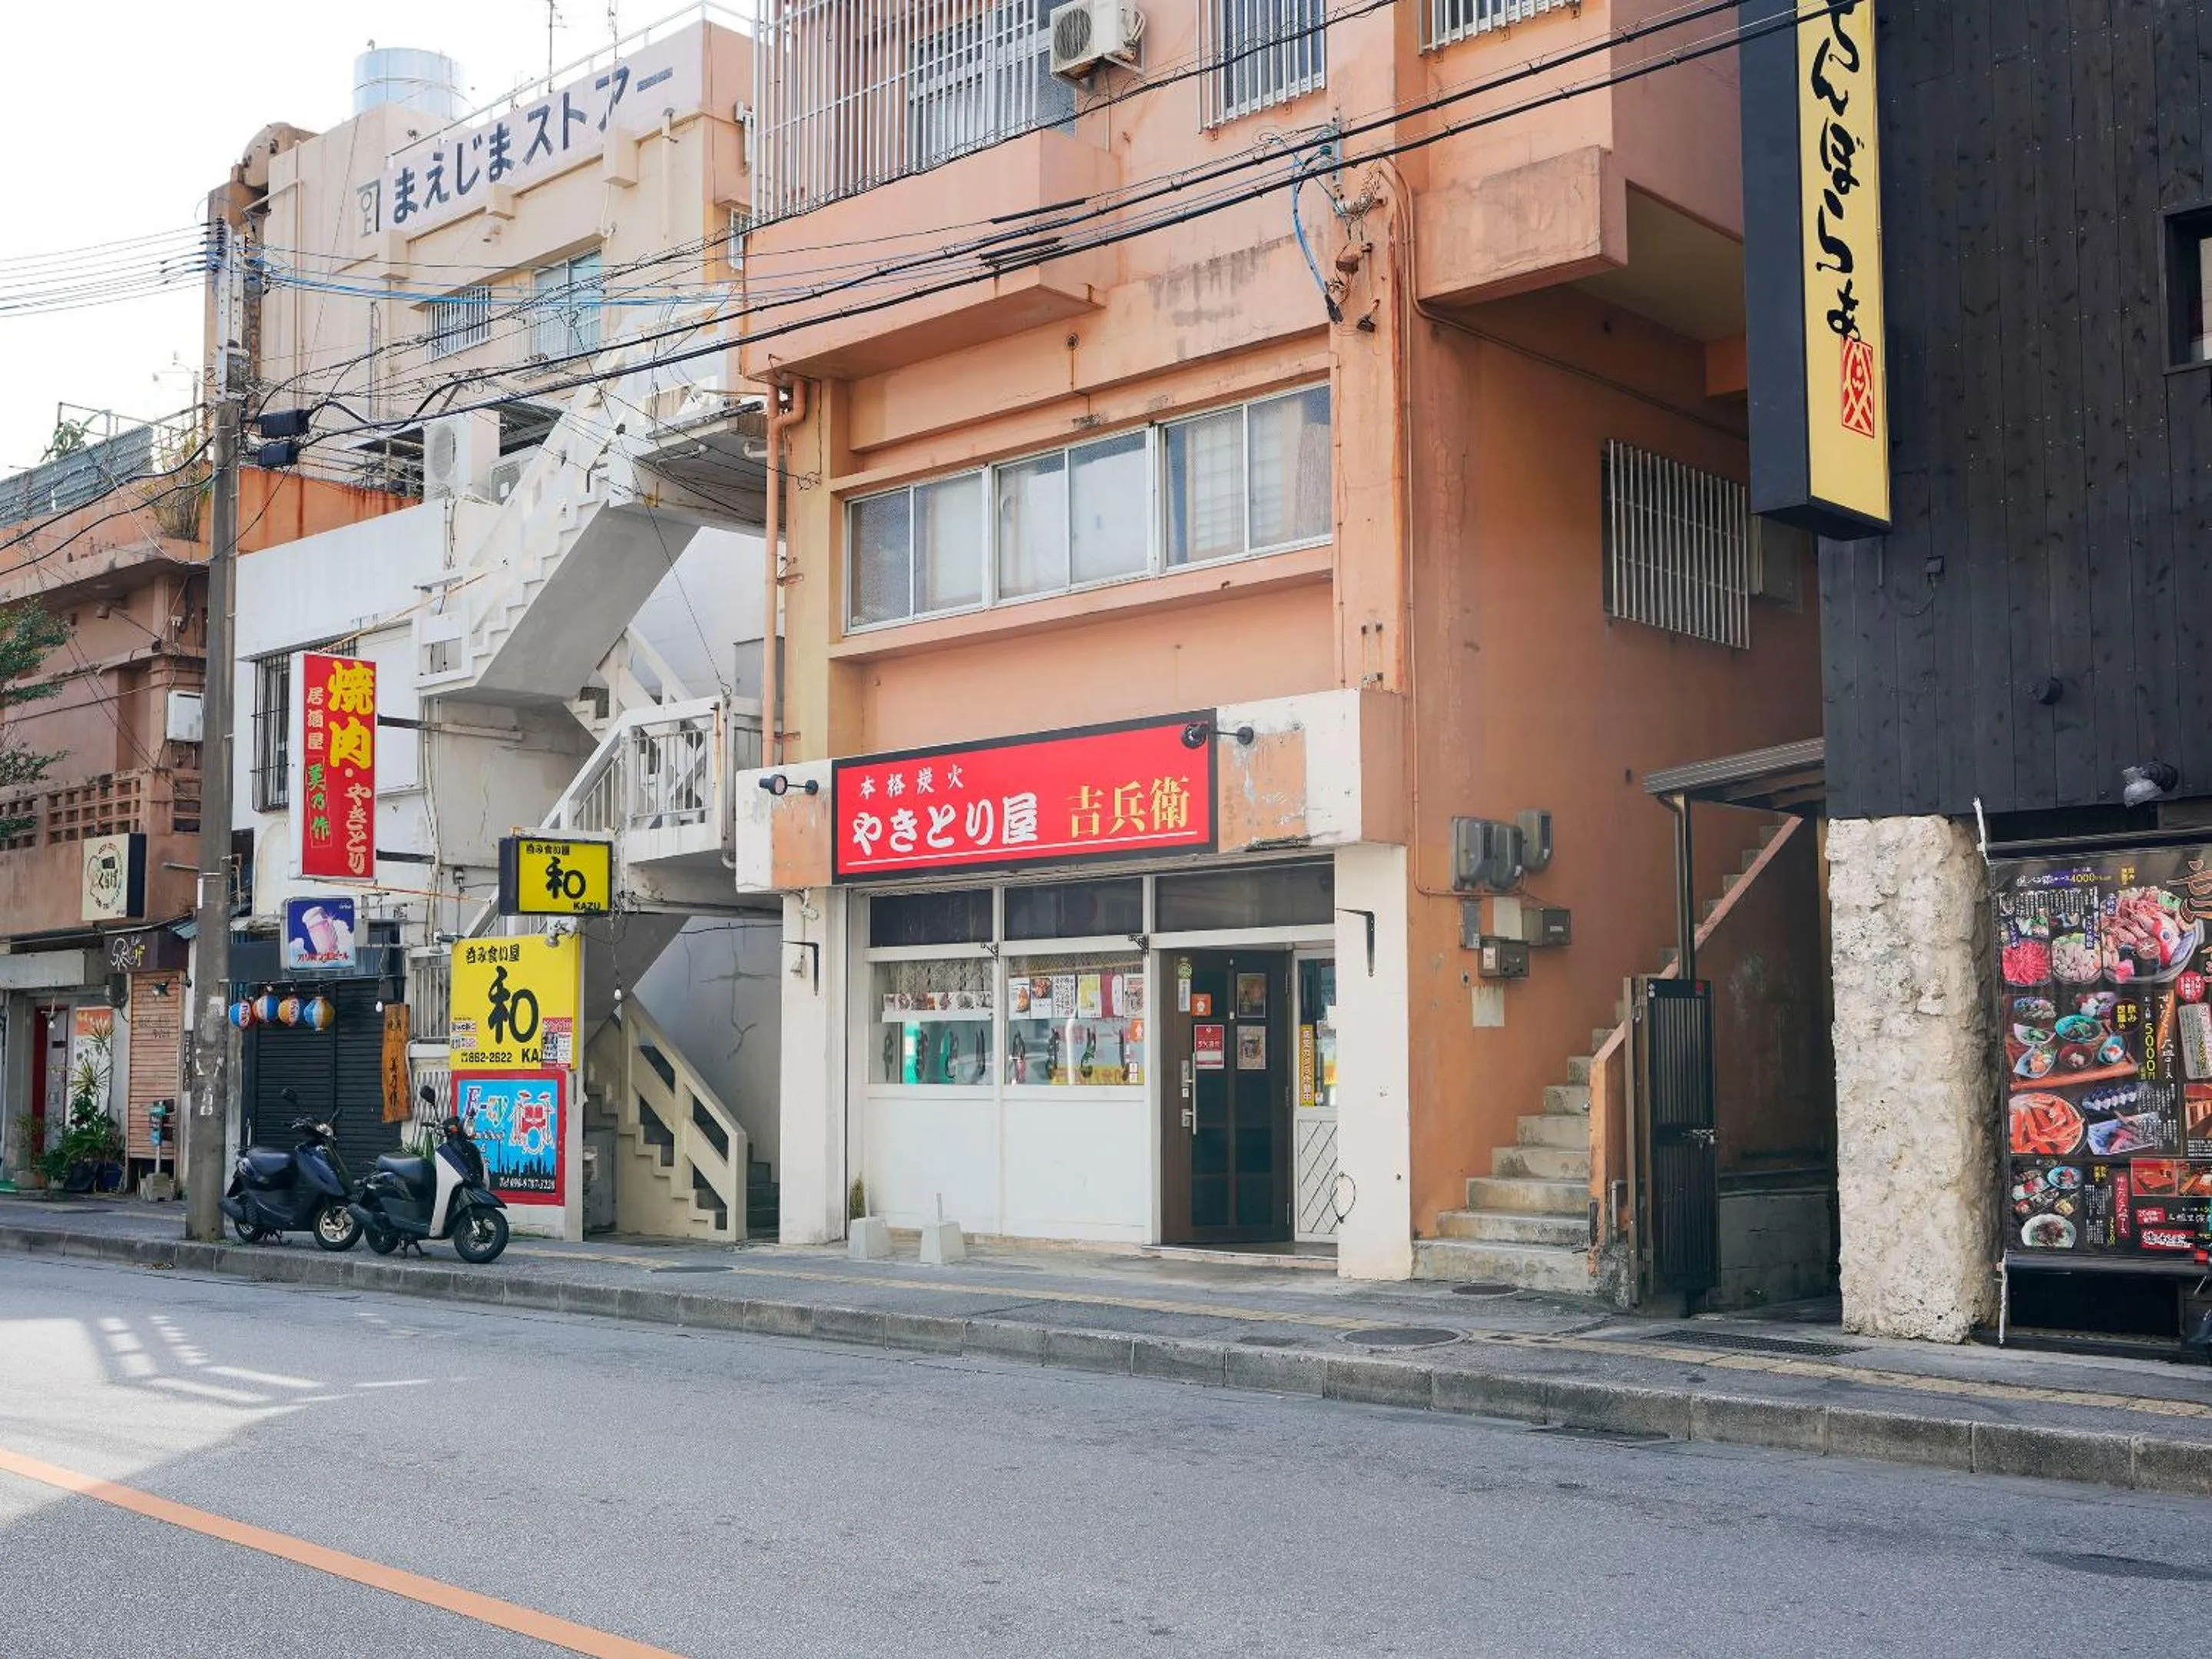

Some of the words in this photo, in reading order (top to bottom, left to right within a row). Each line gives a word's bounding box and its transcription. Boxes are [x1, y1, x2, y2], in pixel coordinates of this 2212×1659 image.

[392, 65, 674, 224] まえじまストアー
[306, 686, 325, 750] 居酒屋
[859, 764, 964, 800] 本格炭火
[852, 792, 1038, 856] やきとり屋
[1066, 776, 1190, 839] 吉兵衛
[545, 856, 586, 899] 和
[573, 902, 601, 910] KAZU
[487, 965, 540, 1044] 和
[521, 1048, 542, 1063] KA
